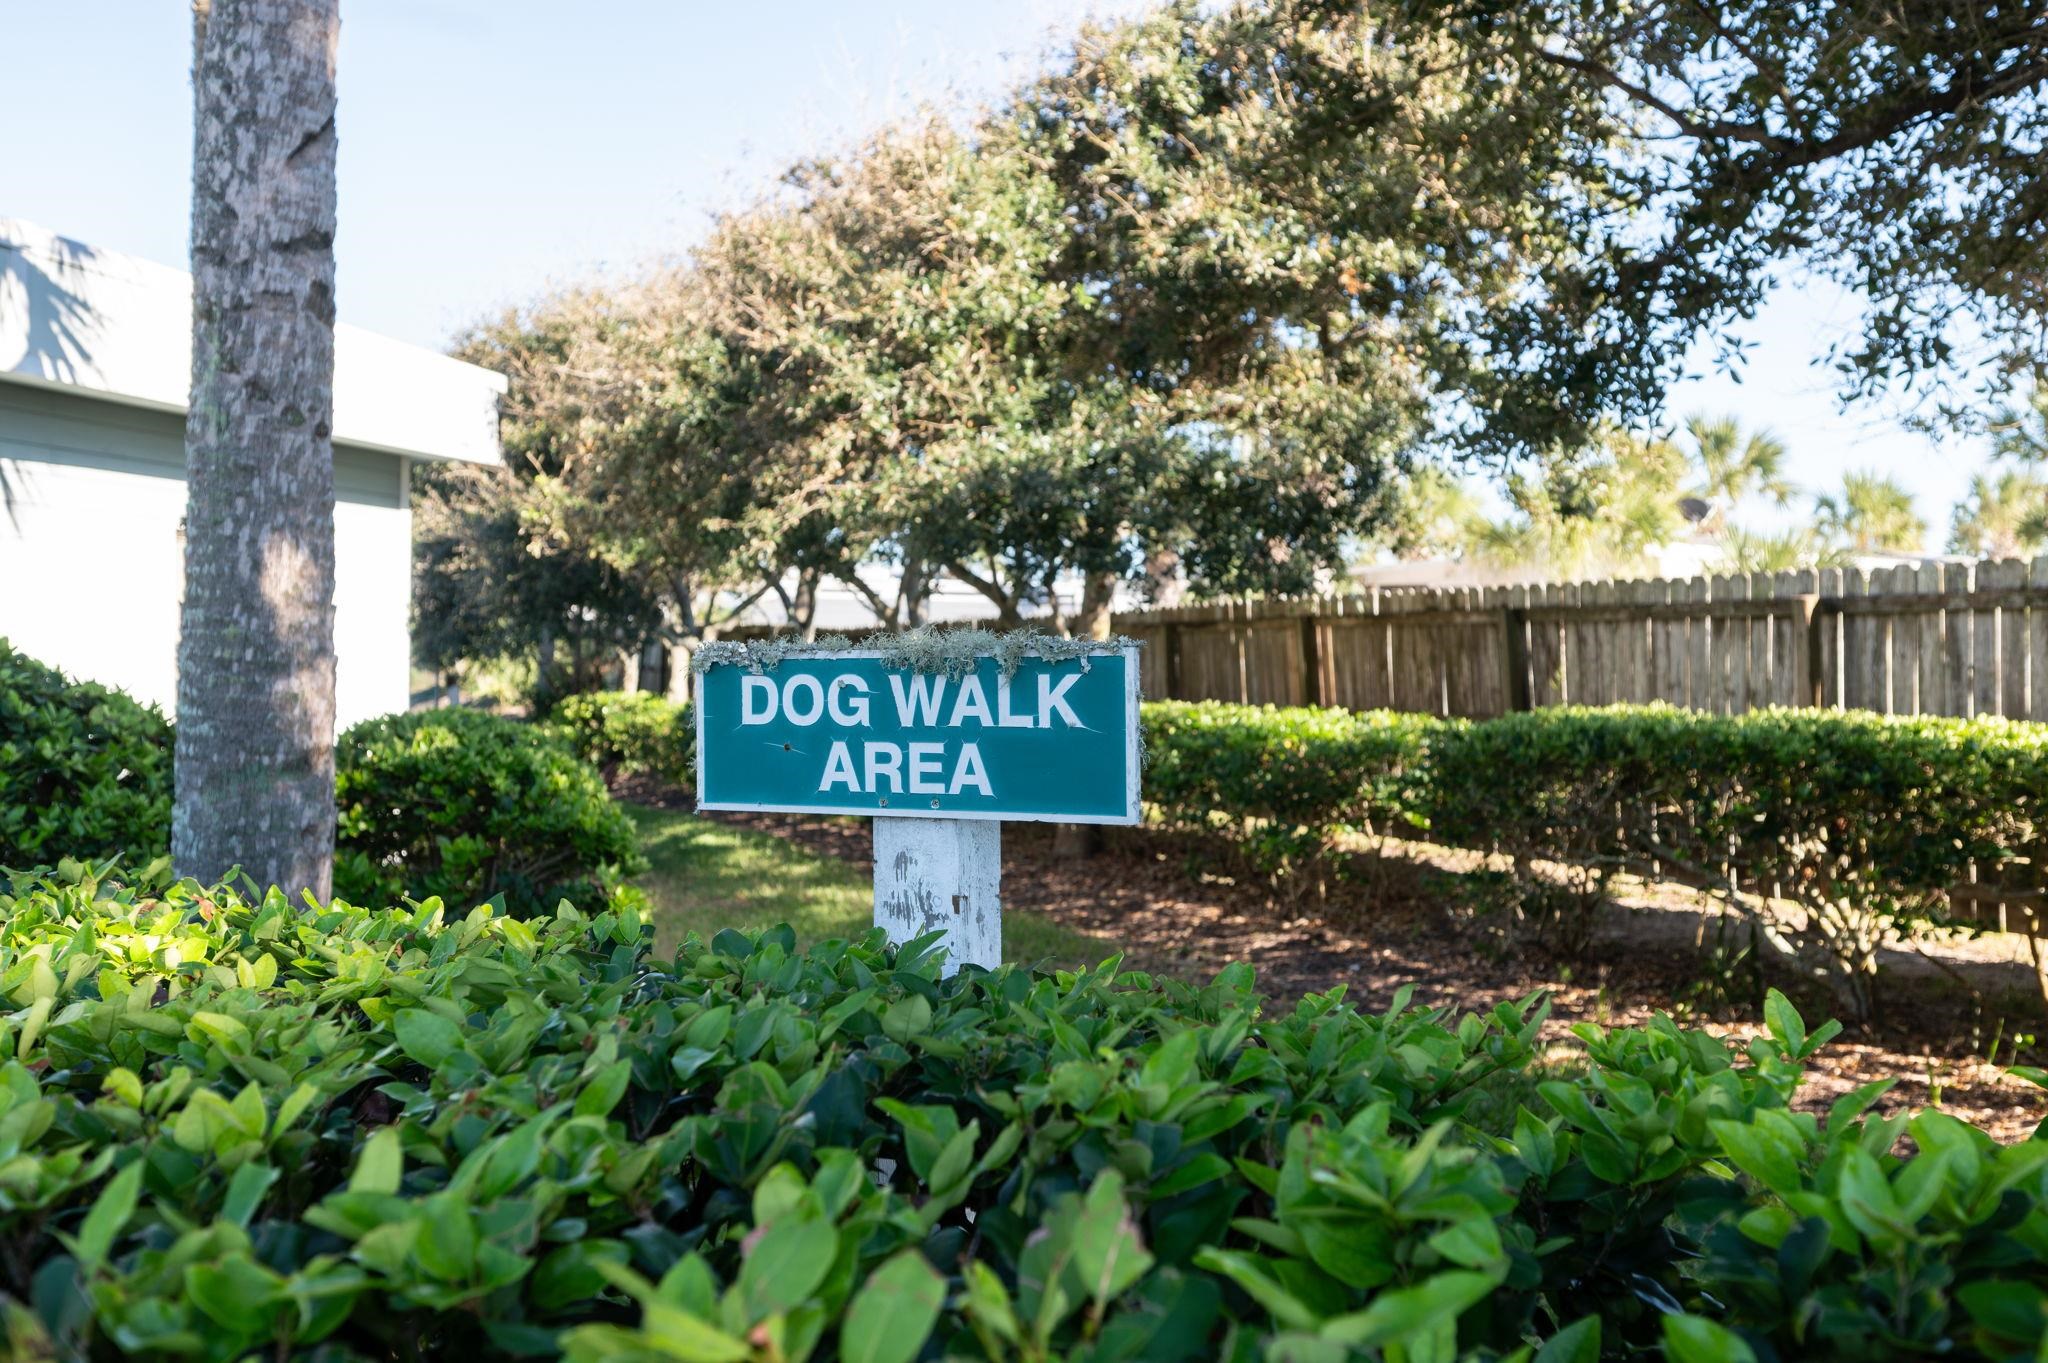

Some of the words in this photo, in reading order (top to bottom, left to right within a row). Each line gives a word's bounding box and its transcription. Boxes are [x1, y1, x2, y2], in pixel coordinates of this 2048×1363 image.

[741, 674, 870, 728] DOG
[888, 673, 1086, 729] WALK
[818, 741, 994, 796] AREA
